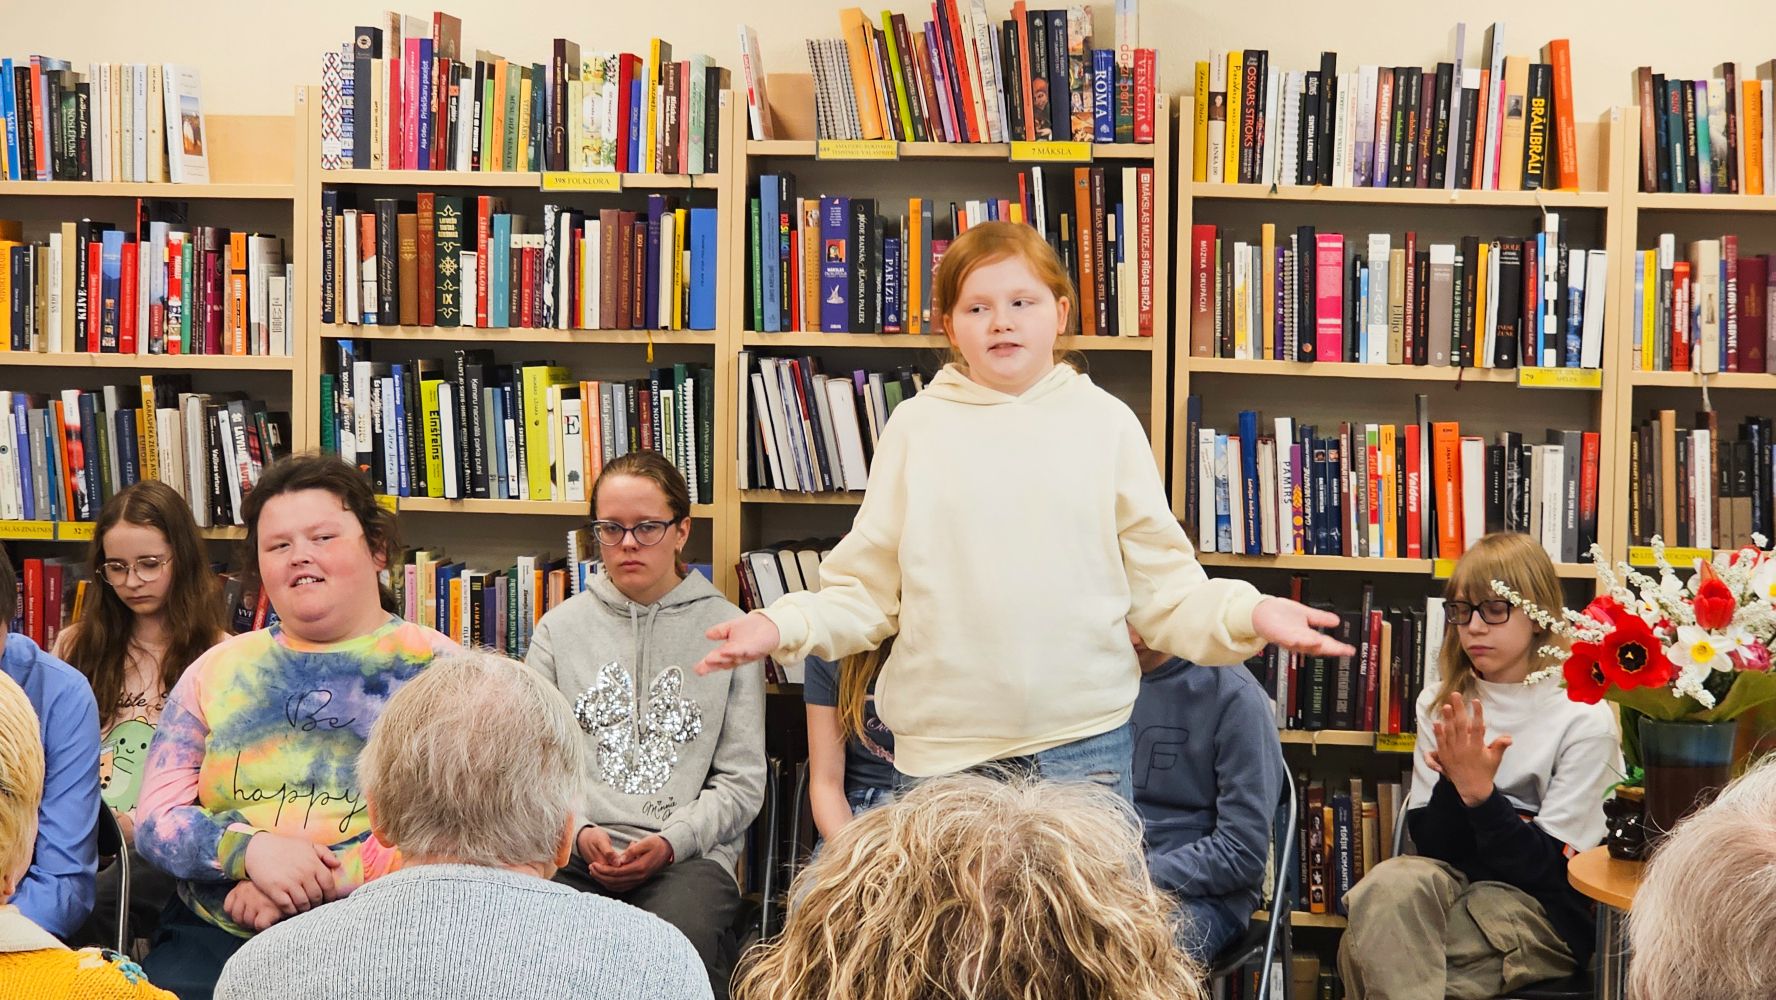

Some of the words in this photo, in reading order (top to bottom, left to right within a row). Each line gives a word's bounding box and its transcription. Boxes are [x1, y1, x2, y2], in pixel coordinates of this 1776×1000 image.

[1095, 69, 1108, 119] ROMA
[1136, 58, 1147, 121] VENĒCIJA
[1246, 66, 1257, 106] OSKARS
[1244, 108, 1255, 148] STROKS
[1528, 98, 1546, 174] BRĀLIBRĀLI
[1038, 146, 1072, 156] MĀKSLA
[1141, 183, 1150, 223] MĀKSLAS
[1095, 208, 1104, 228] RĪGAS
[1141, 224, 1150, 258] MUZEJS
[1200, 240, 1208, 268] MŪZIKA
[326, 250, 332, 259] un
[858, 268, 868, 298] KLASIKA
[885, 258, 896, 304] PARĪZE
[1141, 259, 1152, 286] RĪGAS
[442, 293, 453, 304] IX
[858, 298, 866, 324] PALIEK
[1141, 286, 1151, 312] BIRŽA
[471, 378, 480, 404] Ķemeru
[602, 394, 610, 412] Kāda
[651, 380, 659, 406] ŪDENS
[600, 414, 612, 445] pētnieka
[474, 437, 483, 457] parka
[475, 457, 484, 475] putni
[213, 472, 221, 495] virtuve
[1568, 499, 1575, 509] UN
[286, 690, 356, 732] Be
[233, 750, 368, 834] happy
[642, 796, 677, 819] Minnie
